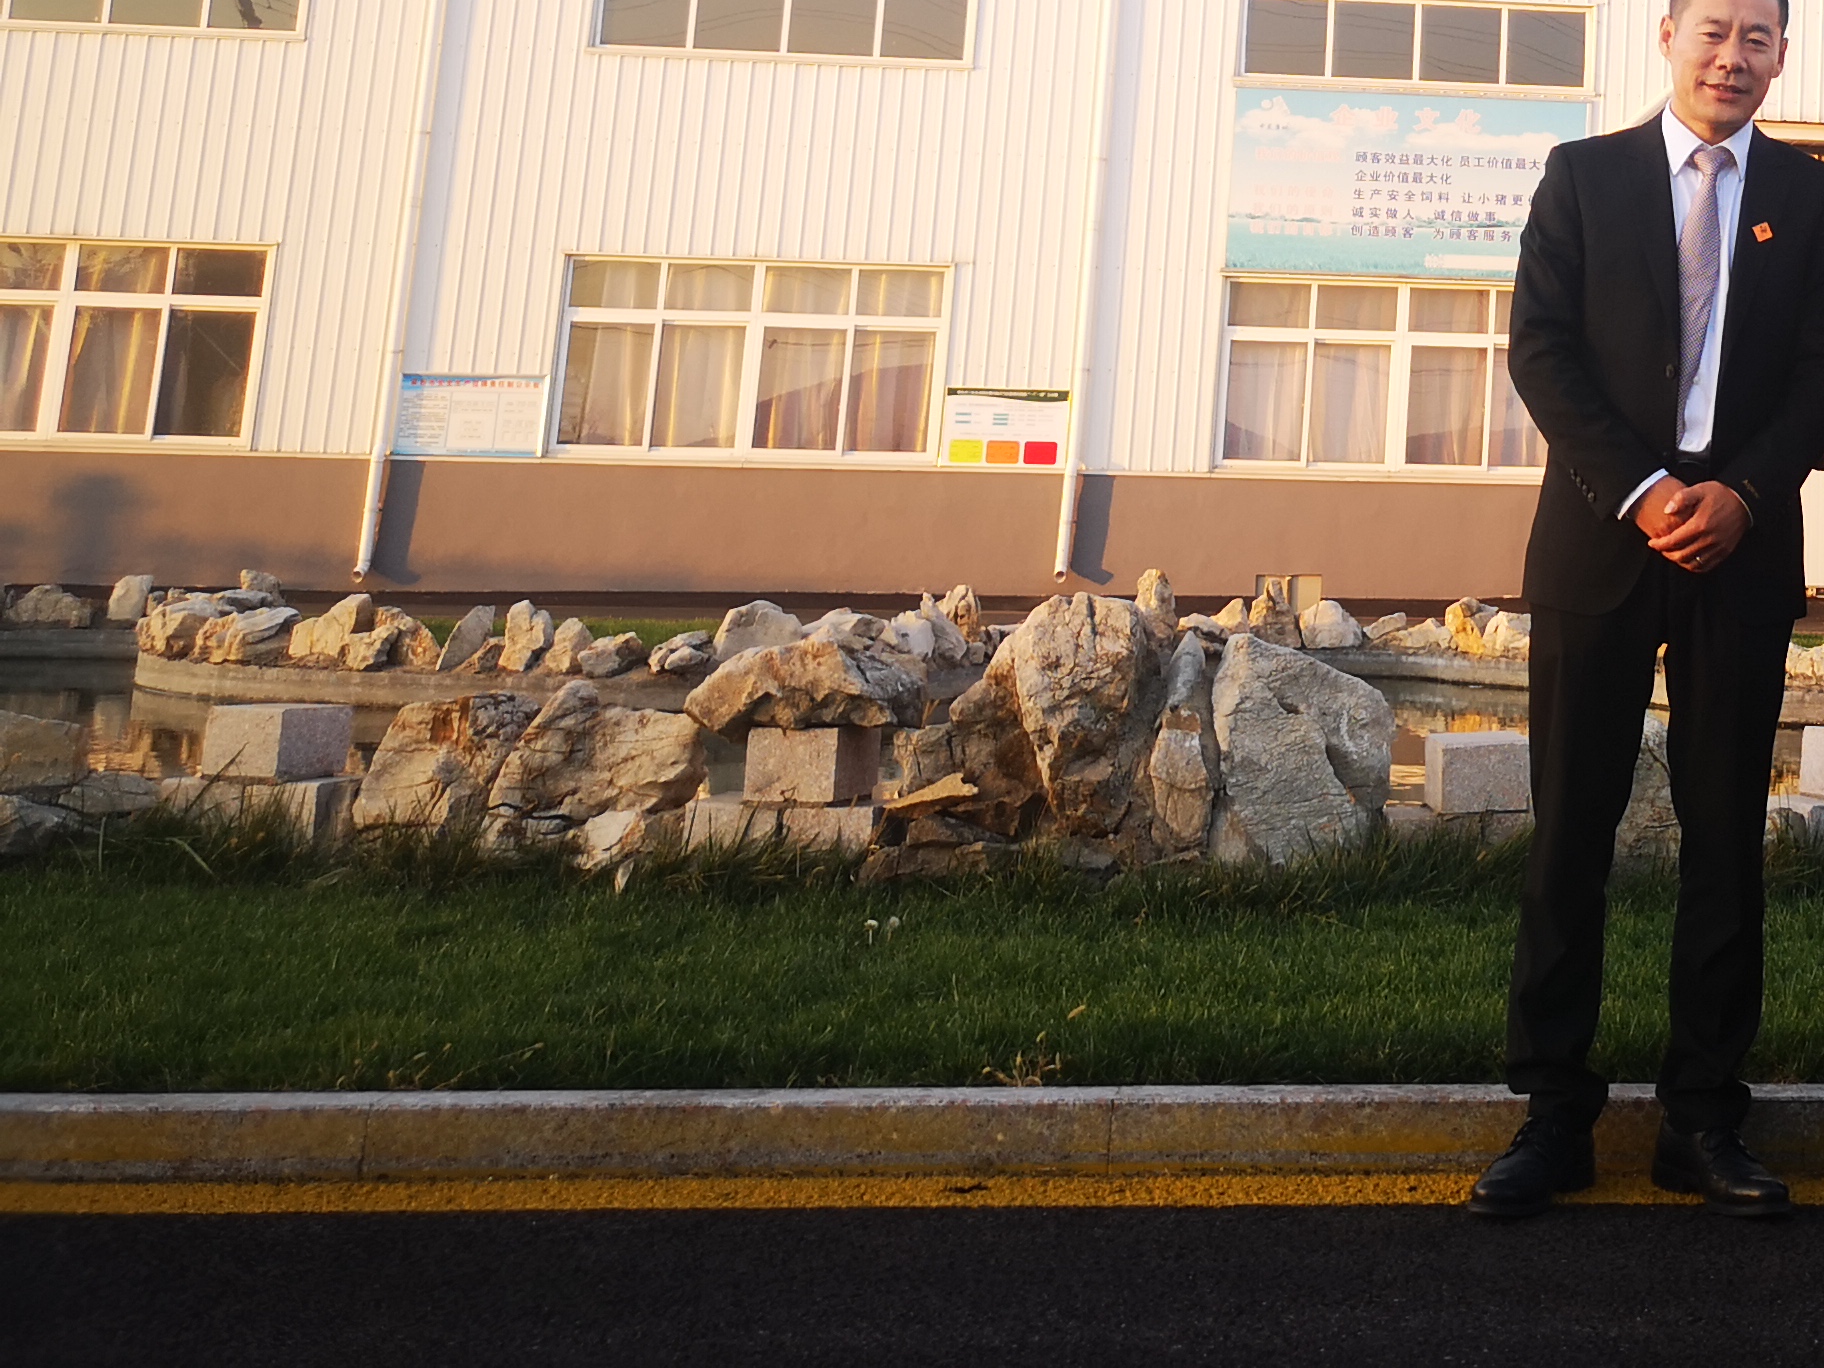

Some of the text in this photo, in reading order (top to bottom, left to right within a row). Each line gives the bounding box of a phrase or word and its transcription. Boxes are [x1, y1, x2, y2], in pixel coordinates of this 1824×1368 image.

[1331, 103, 1482, 134] 企业文化
[1355, 151, 1453, 168] 顾客效益最大化
[1460, 155, 1546, 170] 员工价值最大
[1354, 169, 1452, 186] 企业价值最大化
[1353, 187, 1450, 203] 生产安全饲料
[1461, 192, 1532, 207] 让小猪更
[1351, 205, 1415, 220] 诚实做人
[1433, 209, 1497, 223] 诚信做事
[1350, 224, 1415, 239] 创造顾客
[1433, 227, 1513, 242] 为顾客服务
